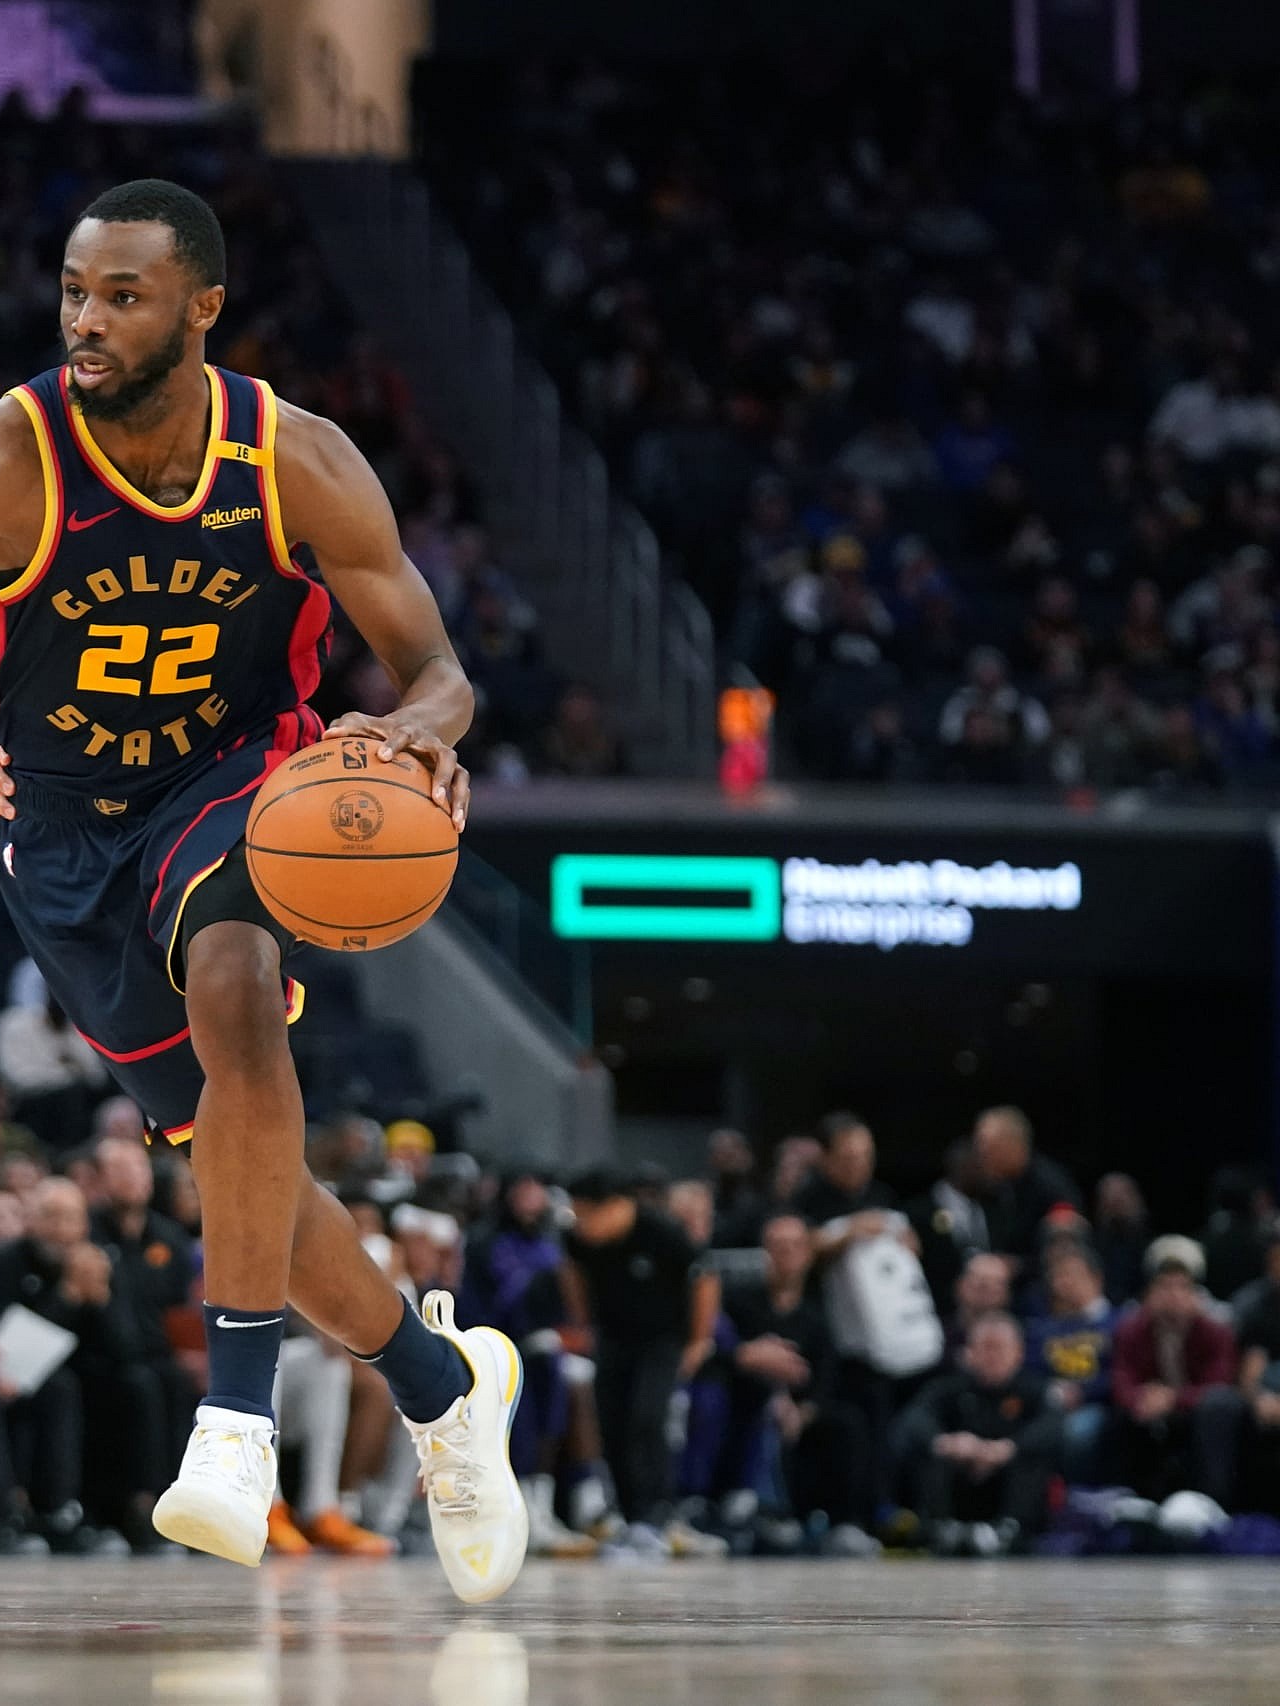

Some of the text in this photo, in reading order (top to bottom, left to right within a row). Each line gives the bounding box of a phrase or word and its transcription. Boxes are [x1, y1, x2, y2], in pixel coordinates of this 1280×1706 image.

[236, 446, 249, 459] 16
[201, 506, 262, 529] Rakuten
[76, 623, 220, 696] 22
[45, 692, 229, 767] STATE
